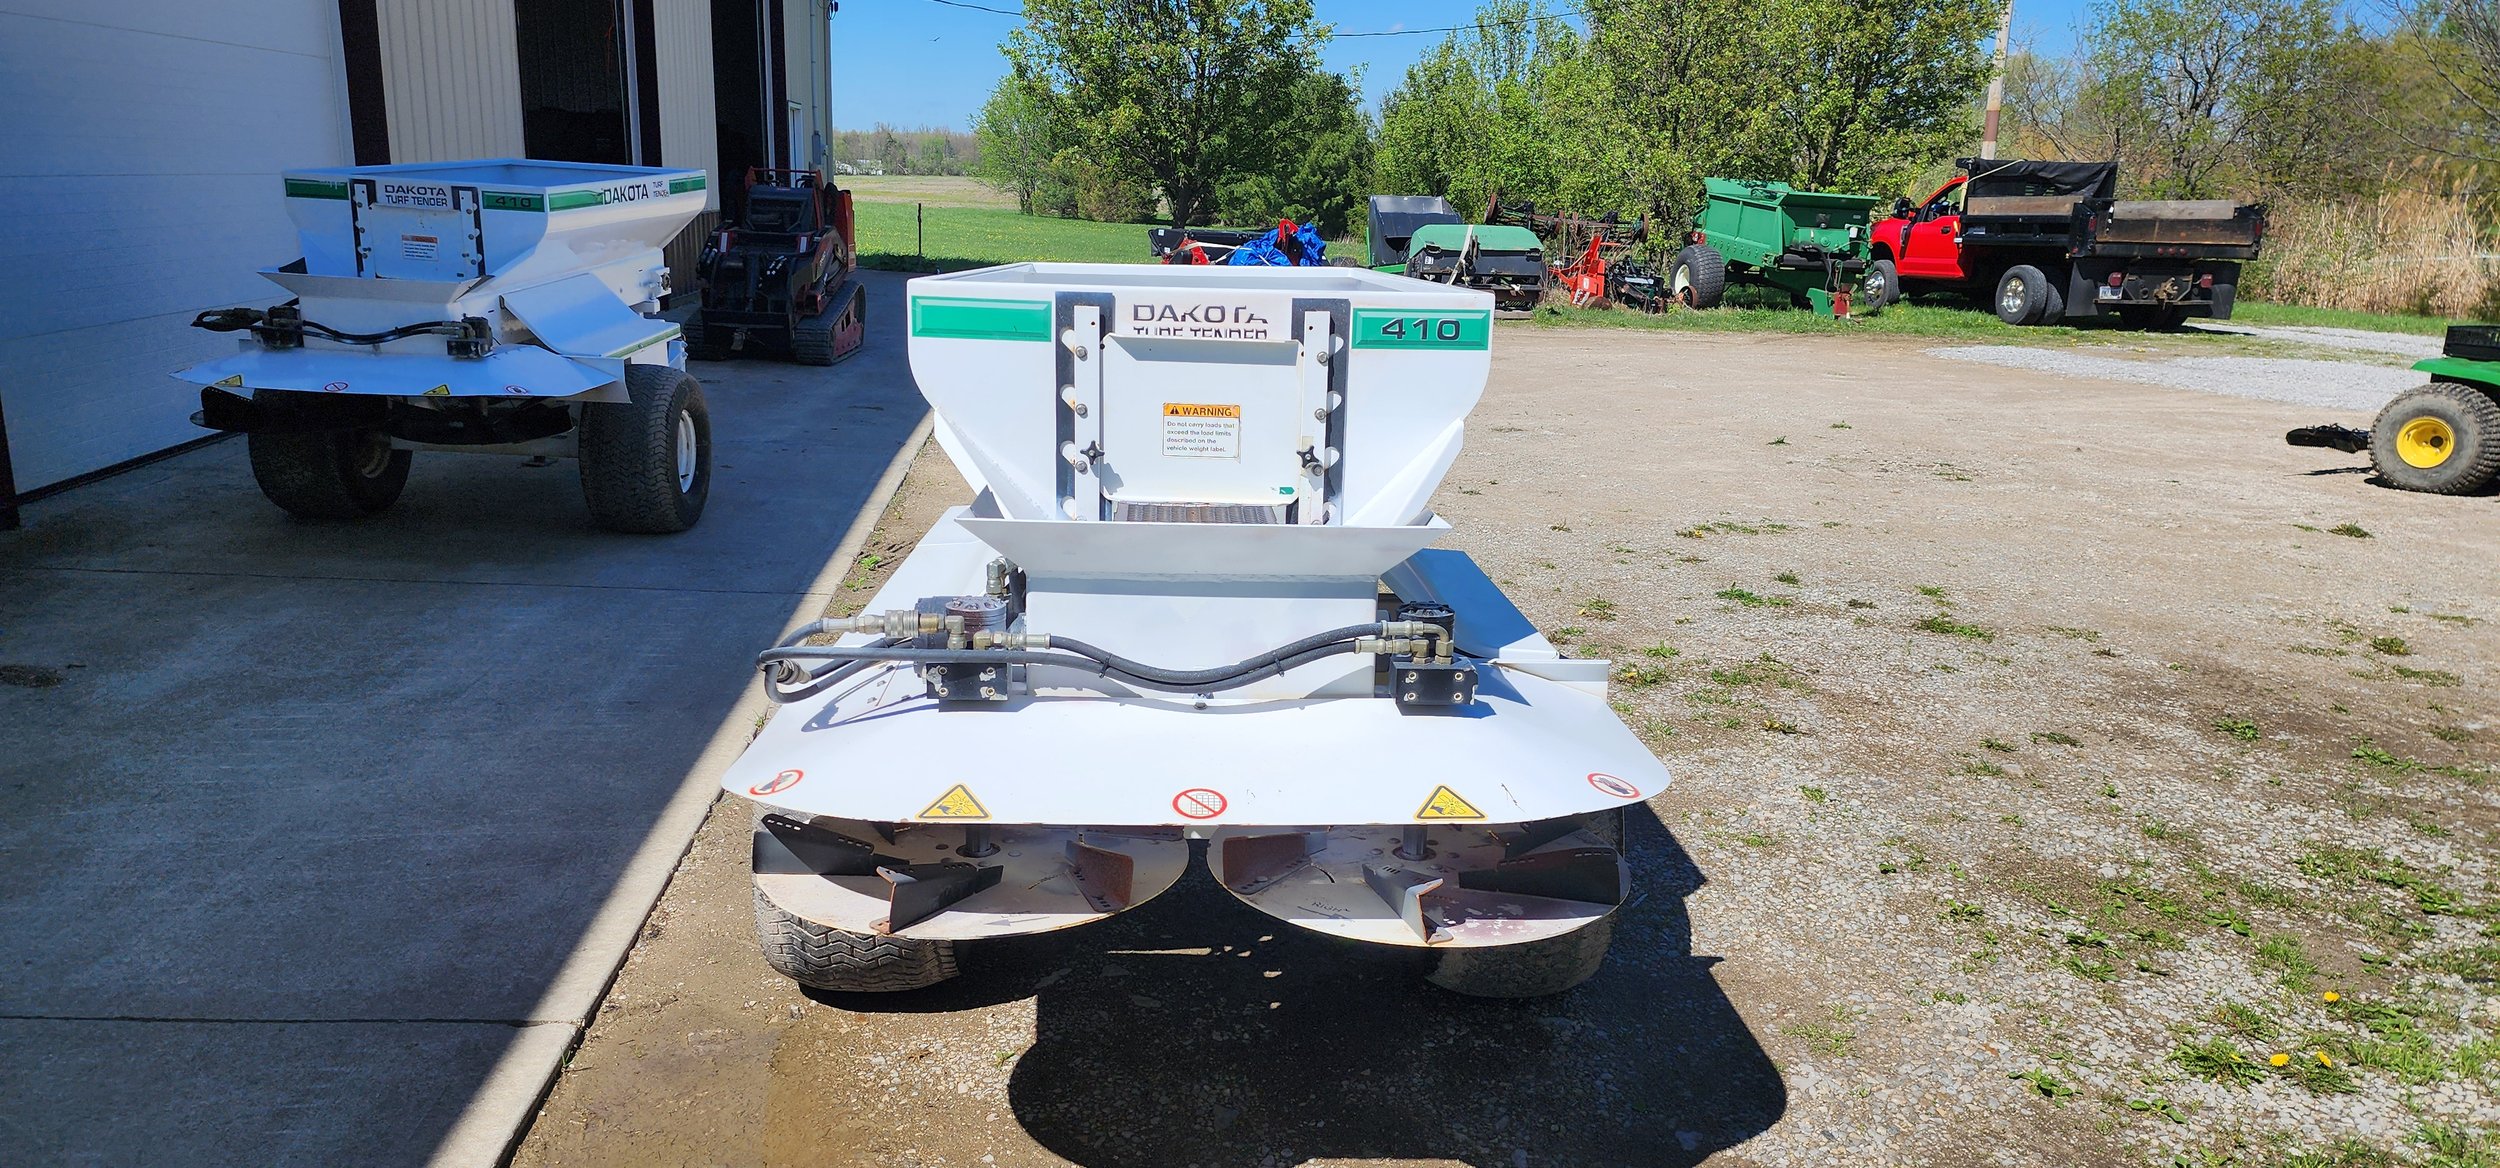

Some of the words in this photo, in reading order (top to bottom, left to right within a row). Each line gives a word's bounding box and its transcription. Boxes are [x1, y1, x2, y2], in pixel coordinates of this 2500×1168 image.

[385, 185, 447, 196] DAKOTA
[603, 183, 649, 205] DAKOTA
[386, 195, 409, 204] TURF
[411, 196, 448, 206] TENDER
[495, 196, 531, 208] 410
[1132, 303, 1269, 324] DAKOTA
[1381, 317, 1461, 341] 410
[1182, 407, 1232, 416] WARNING
